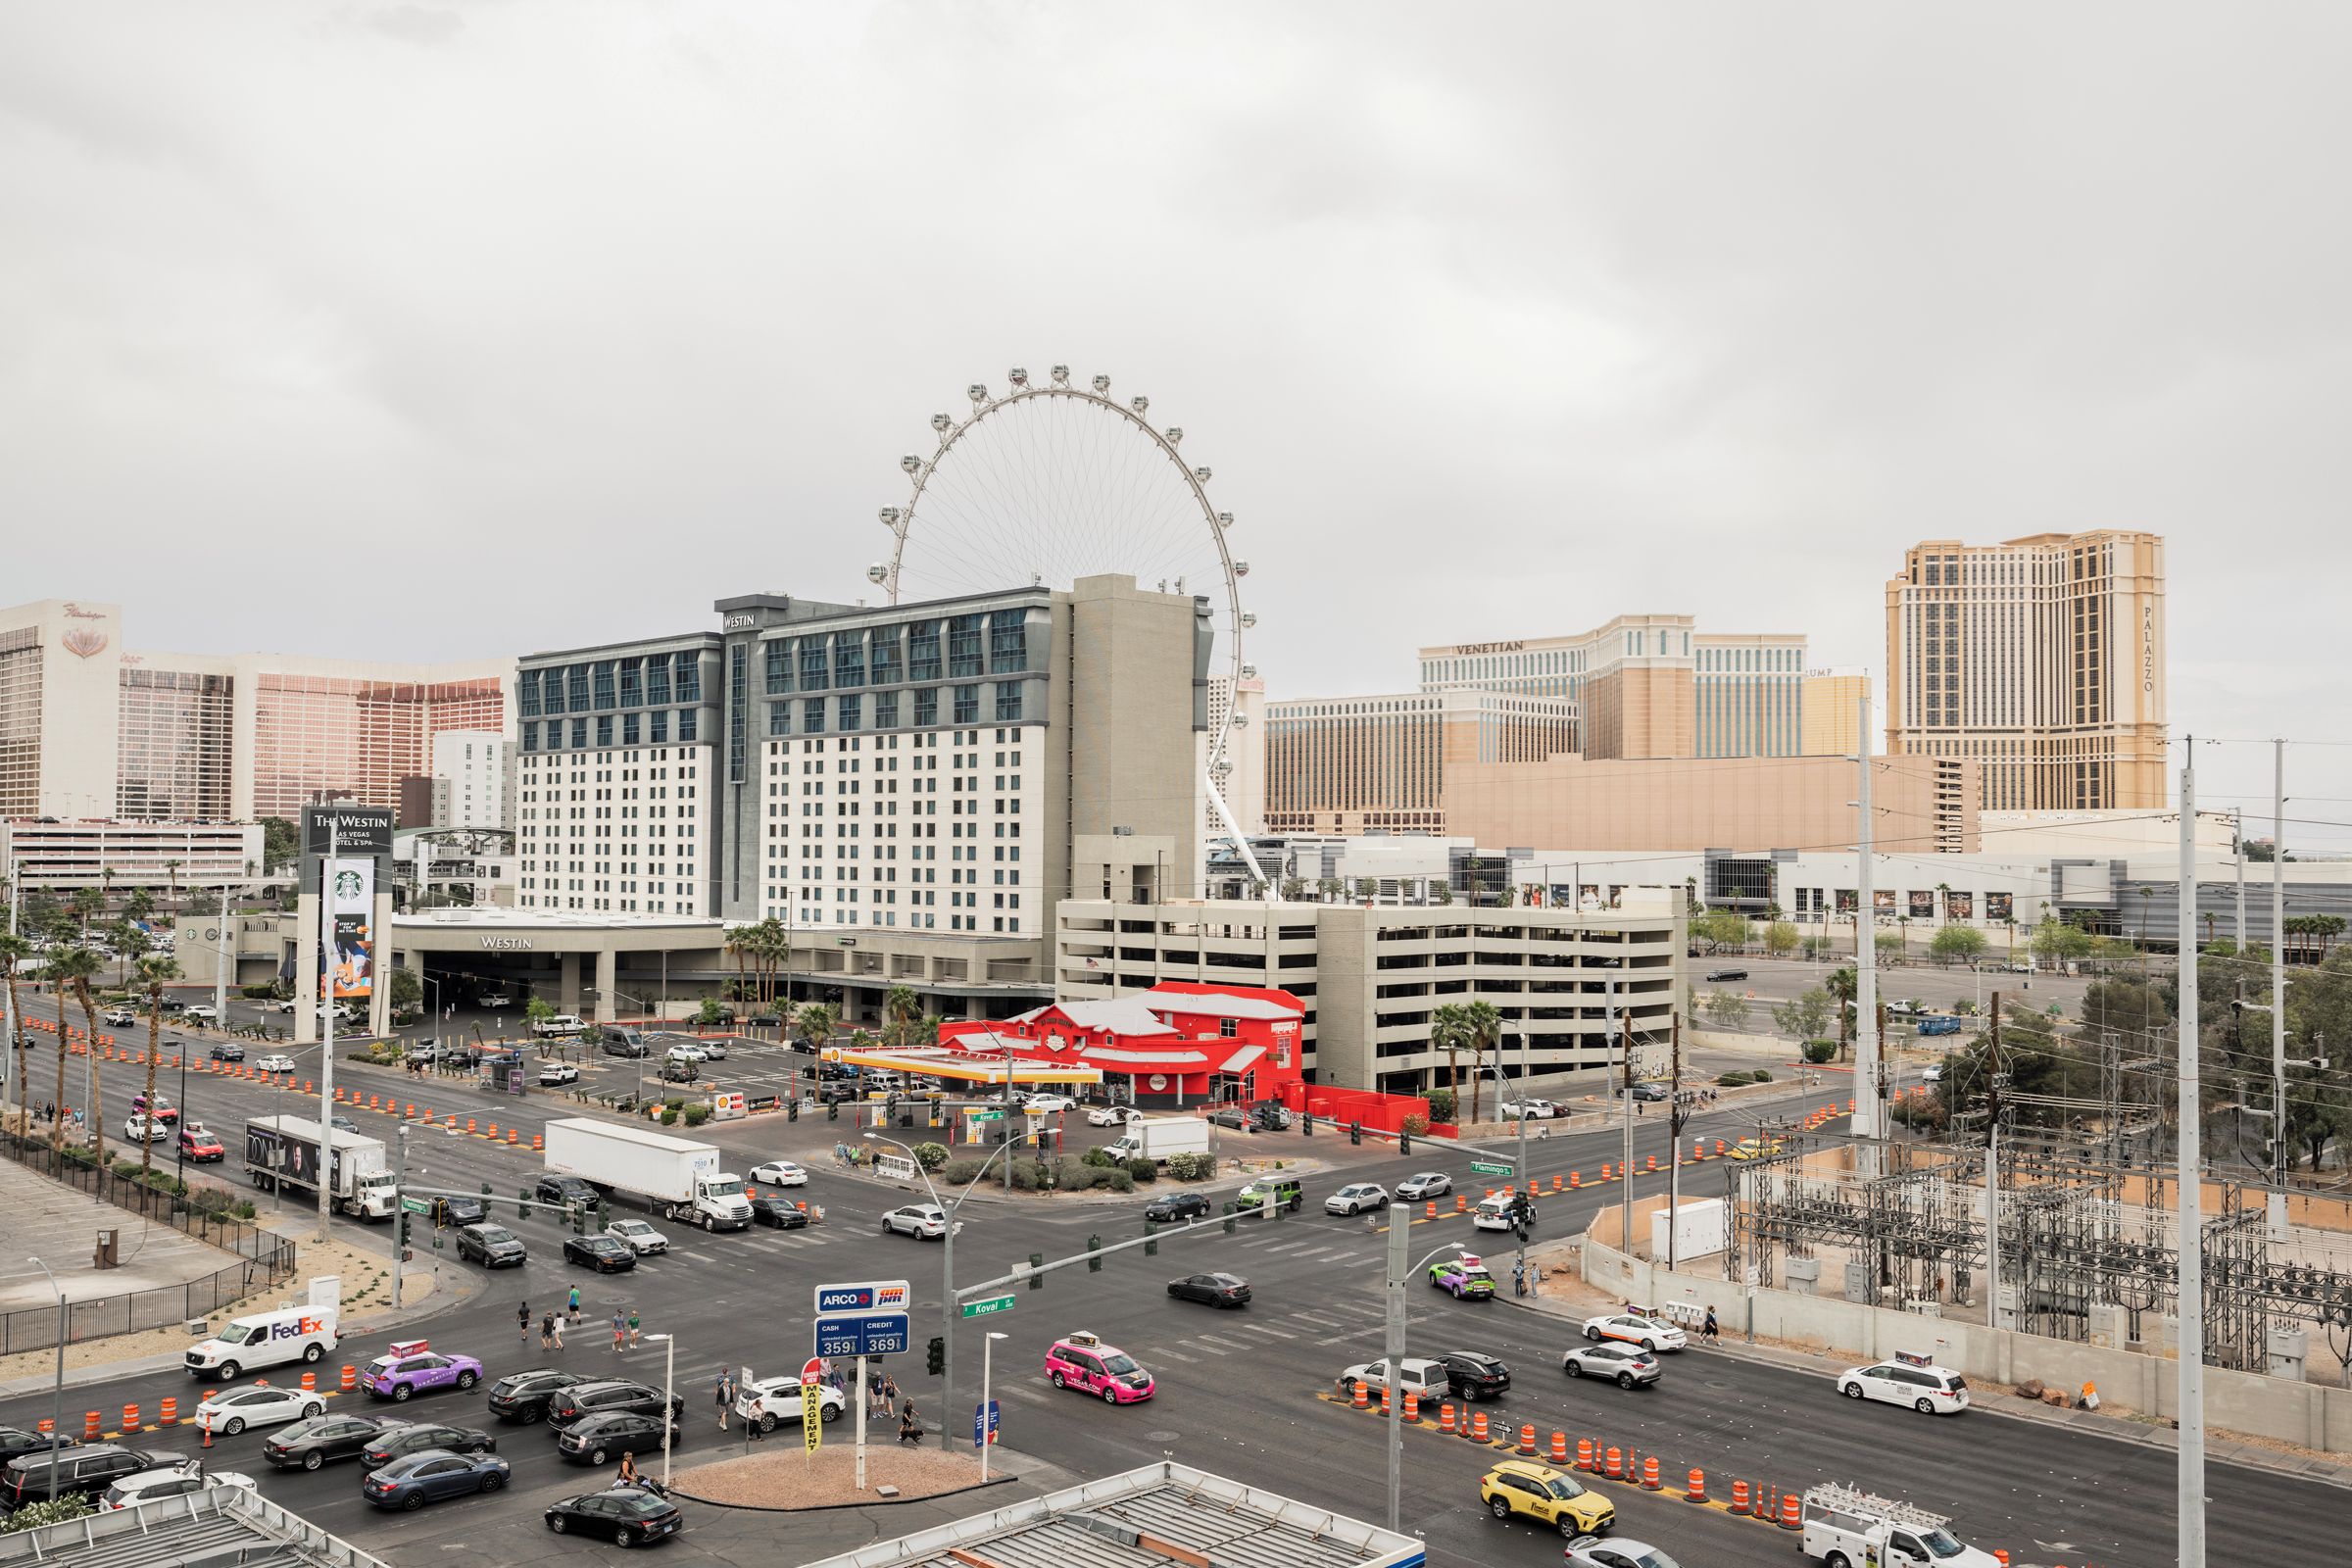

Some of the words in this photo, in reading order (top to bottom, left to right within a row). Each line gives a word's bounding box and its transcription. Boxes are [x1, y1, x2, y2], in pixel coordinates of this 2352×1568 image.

[724, 614, 755, 628] WESTIN
[1456, 640, 1523, 656] VENETIAN
[2144, 607, 2153, 692] PALAZZO
[340, 815, 388, 828] WESTIN
[480, 936, 532, 949] WESTIN
[1475, 1164, 1503, 1175] Flamingo
[823, 1294, 858, 1305] ARCO
[976, 1301, 998, 1314] Koval
[271, 1316, 324, 1341] FedEx
[824, 1342, 851, 1354] 359
[868, 1339, 895, 1351] 369
[1070, 1376, 1101, 1391] VEGAS.COM
[807, 1385, 817, 1451] MANAGEMENT
